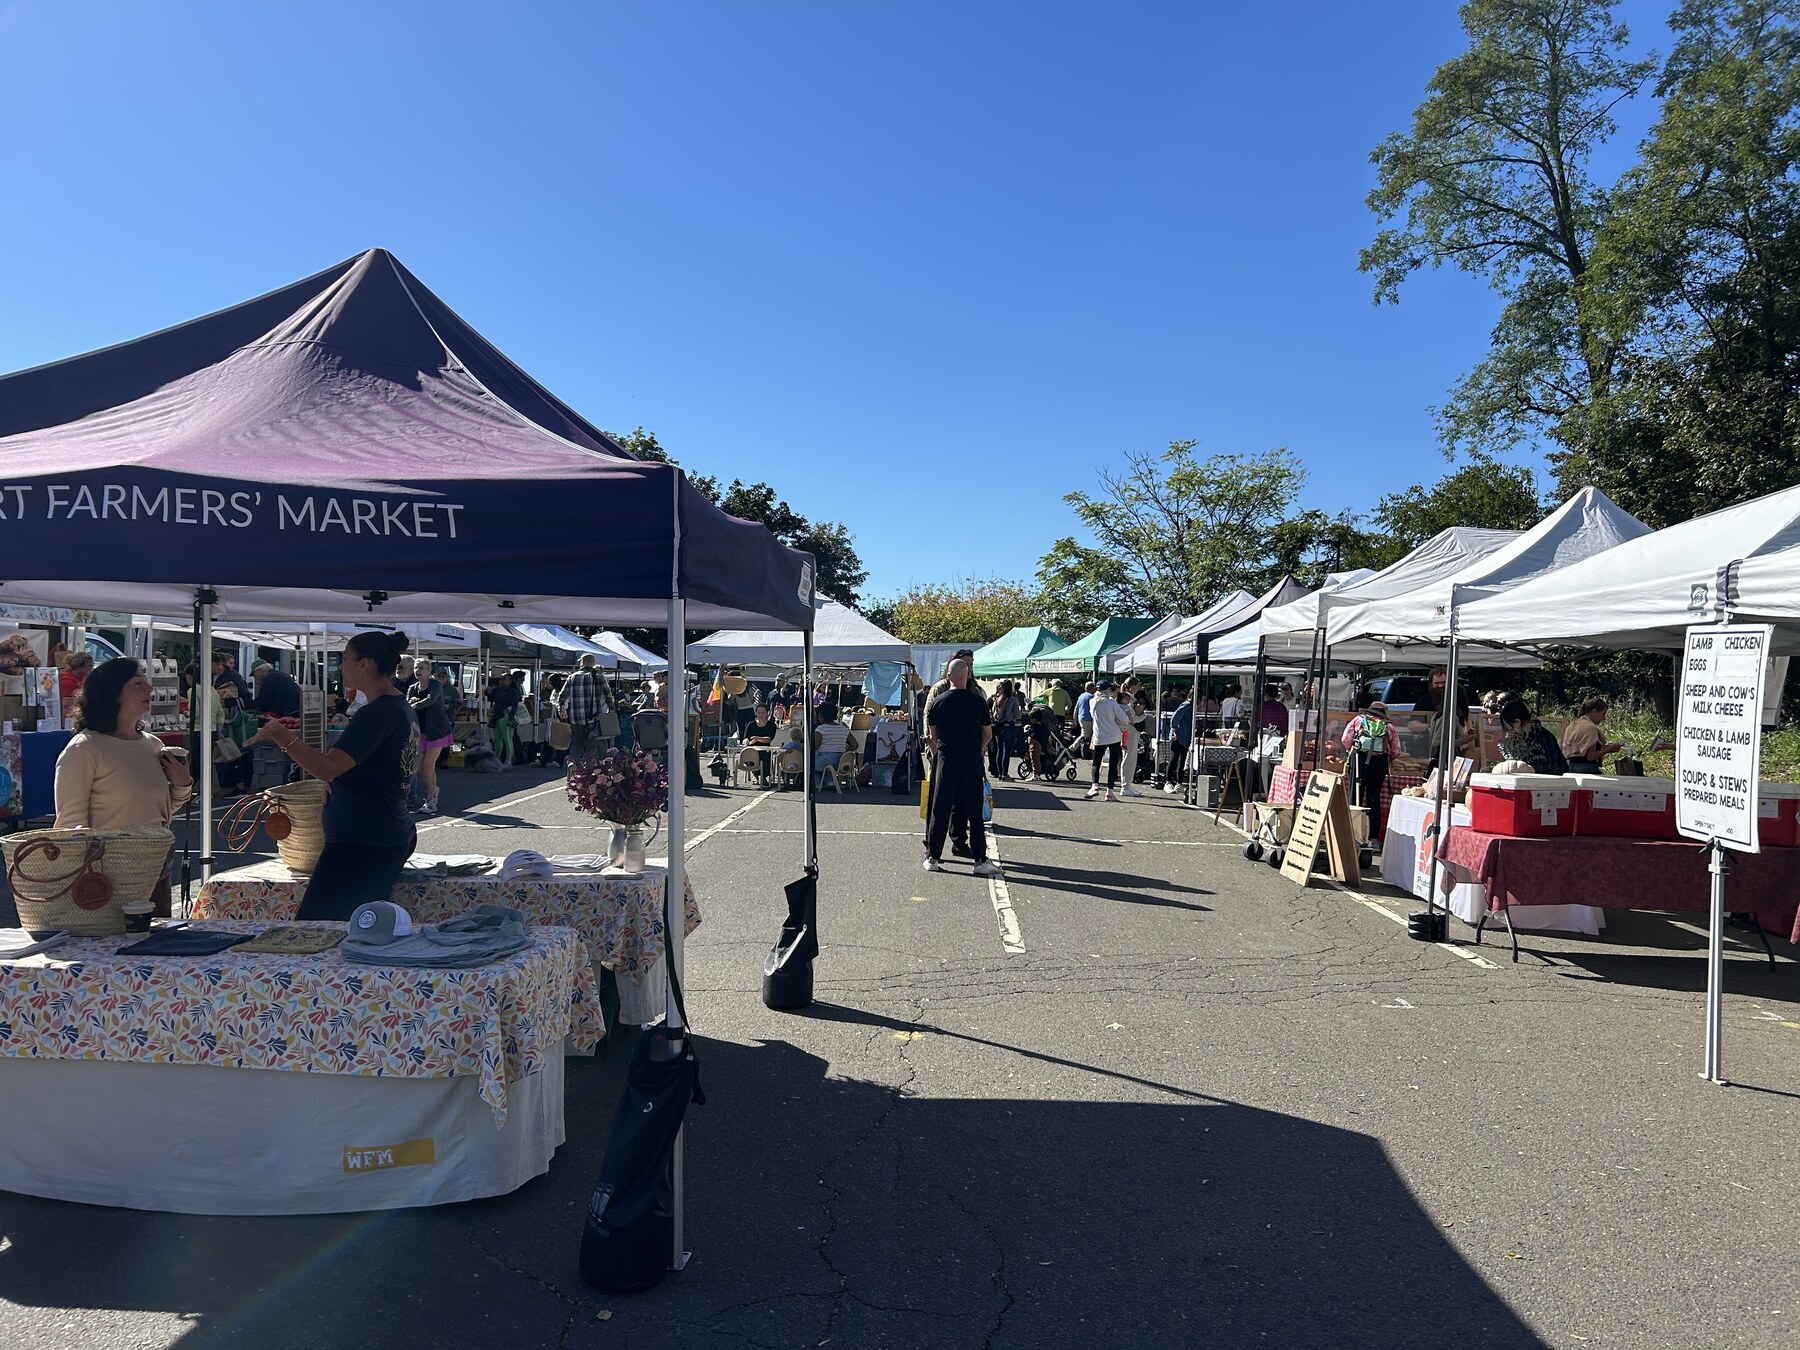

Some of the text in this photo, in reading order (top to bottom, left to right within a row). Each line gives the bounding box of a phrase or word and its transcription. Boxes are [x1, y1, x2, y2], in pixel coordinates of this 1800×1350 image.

[0, 484, 464, 538] T FARMERS’ MARKET
[1691, 636, 1761, 650] LAMB CHICKEN
[1689, 658, 1707, 671] EGGS
[1685, 684, 1755, 700] SHEEP AND COW'S
[1692, 701, 1744, 717] MILK CHEESE
[1683, 726, 1751, 746] CHICKEN & LAMB
[1697, 745, 1732, 761] SAUSAGE
[1682, 769, 1748, 794] SOUPS & STEWS
[1684, 788, 1745, 811] PREPARED MEALS
[346, 1149, 394, 1169] WFM
